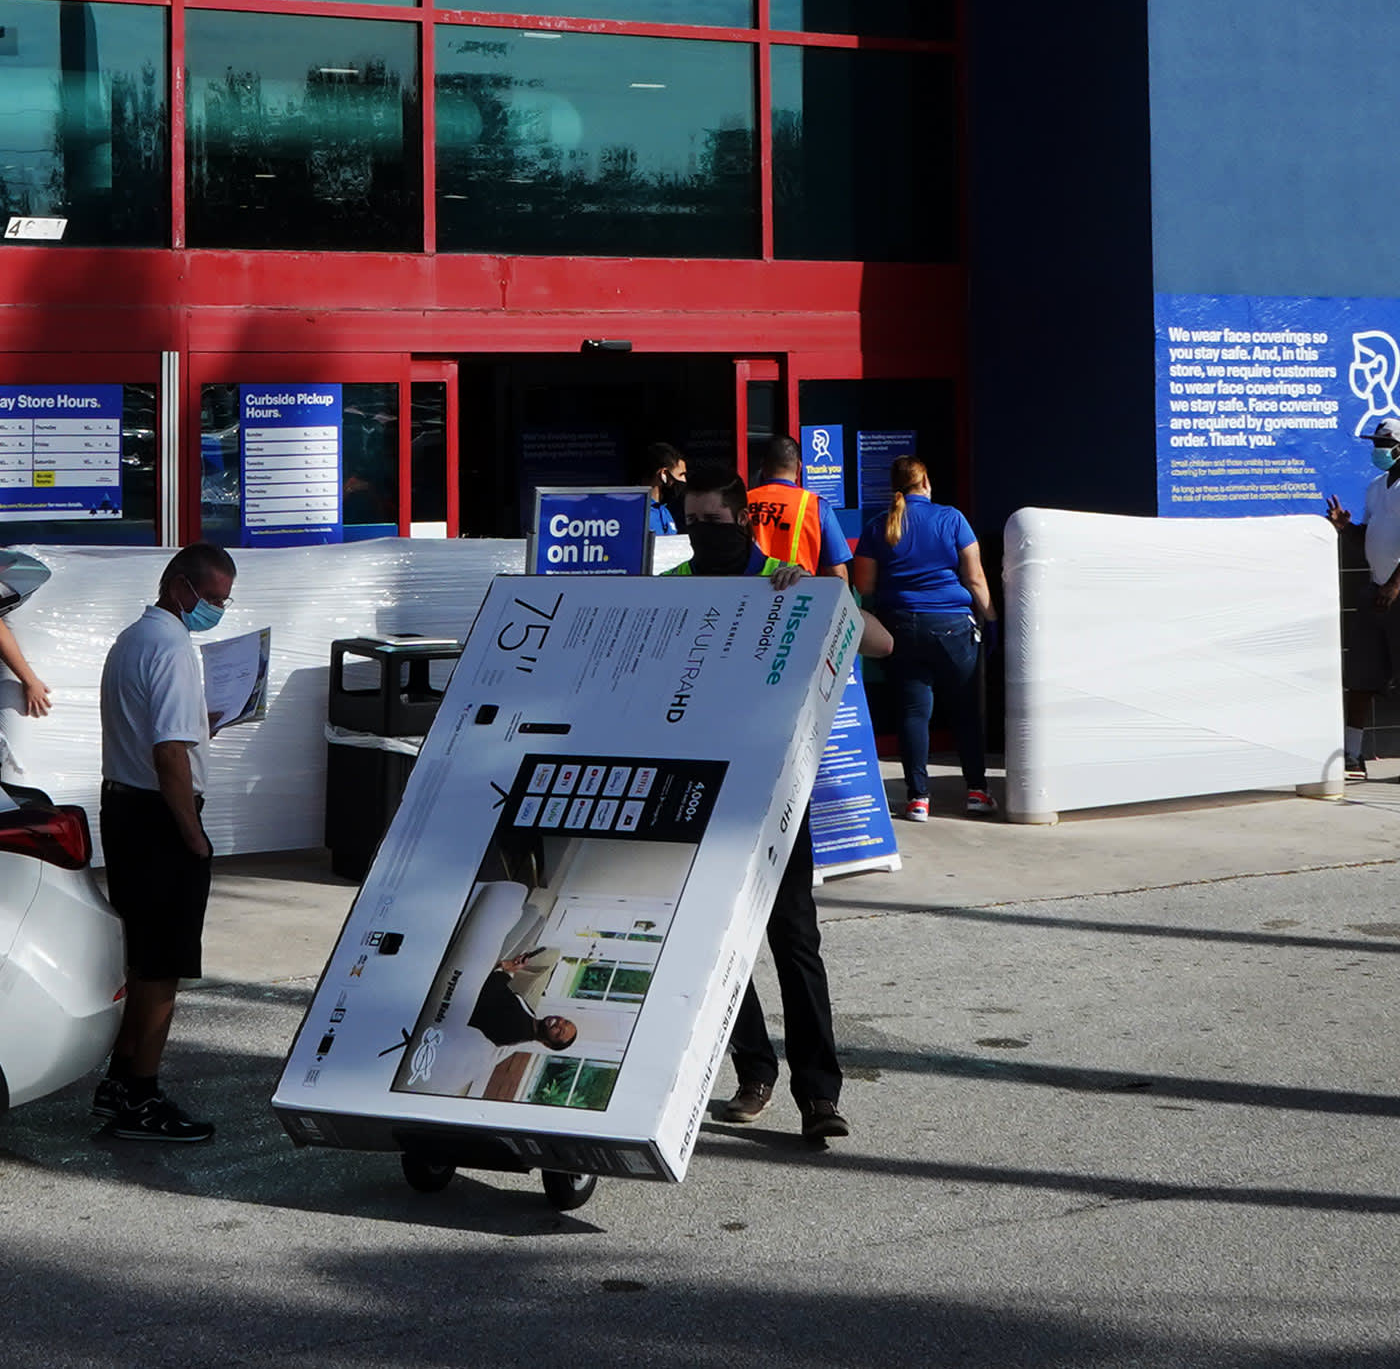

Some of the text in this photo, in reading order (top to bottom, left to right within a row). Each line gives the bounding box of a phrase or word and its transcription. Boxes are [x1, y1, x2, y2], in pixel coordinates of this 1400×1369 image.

[1169, 327, 1328, 346] We wear face coverings so
[1169, 346, 1318, 362] you stay safe. And, in this
[1169, 364, 1336, 380] store, we require customers
[1170, 380, 1321, 397] to wear face coverings so
[18, 395, 55, 408] Store
[57, 395, 101, 408] Hours.
[246, 394, 333, 406] Curbside Pickup
[1170, 398, 1338, 414] we stay safe. Face coverings
[246, 408, 281, 418] Hours.
[1170, 415, 1337, 431] are required by government
[1171, 433, 1275, 448] order. Thank you.
[749, 502, 788, 514] BEST
[550, 514, 620, 537] Come
[751, 513, 782, 527] BUY
[547, 539, 609, 563] on in.
[703, 605, 721, 635] 4K
[754, 595, 785, 661] androidtv
[766, 595, 813, 686] Hisense
